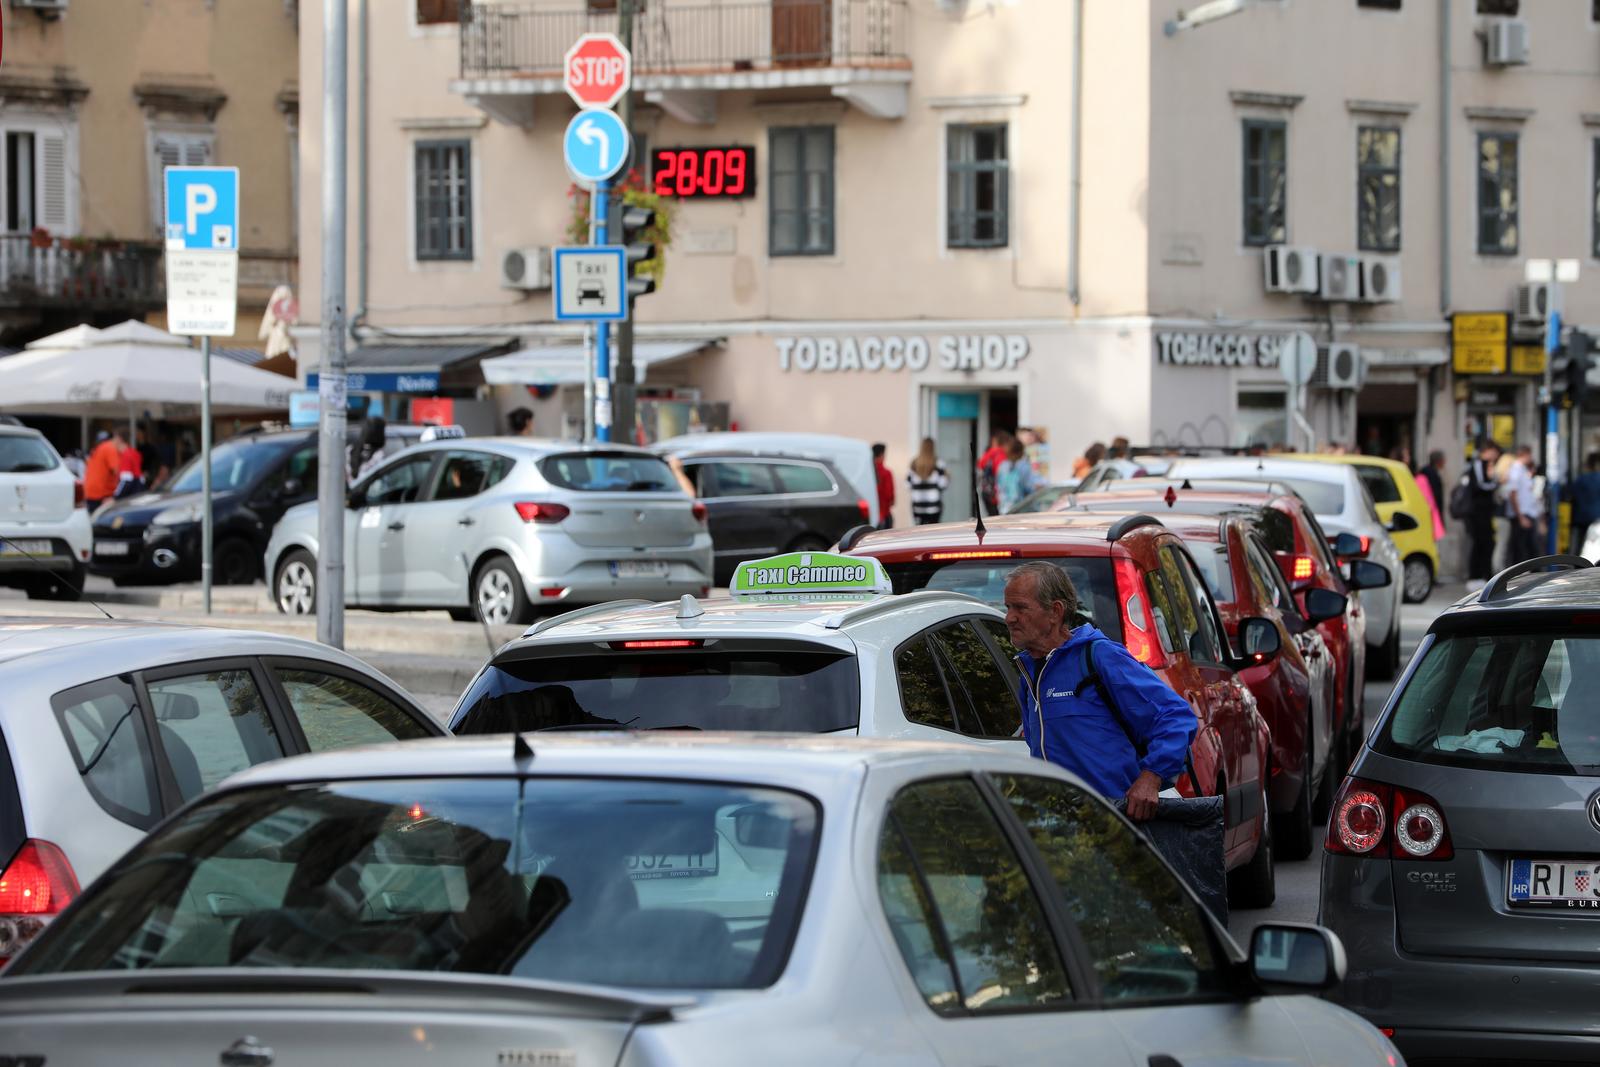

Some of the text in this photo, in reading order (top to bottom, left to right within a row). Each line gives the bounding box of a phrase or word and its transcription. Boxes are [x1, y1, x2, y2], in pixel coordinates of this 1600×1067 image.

[570, 56, 623, 86] STOP
[655, 150, 747, 196] 28.09
[186, 183, 217, 235] P
[576, 260, 608, 276] Taxi
[775, 335, 1030, 372] TOBACCO SHOP
[1157, 332, 1289, 368] TOBACCO SH
[787, 564, 867, 586] Cammeo
[1406, 871, 1457, 883] GOLF
[1425, 884, 1457, 892] PLUS
[1513, 864, 1565, 896] HR RI
